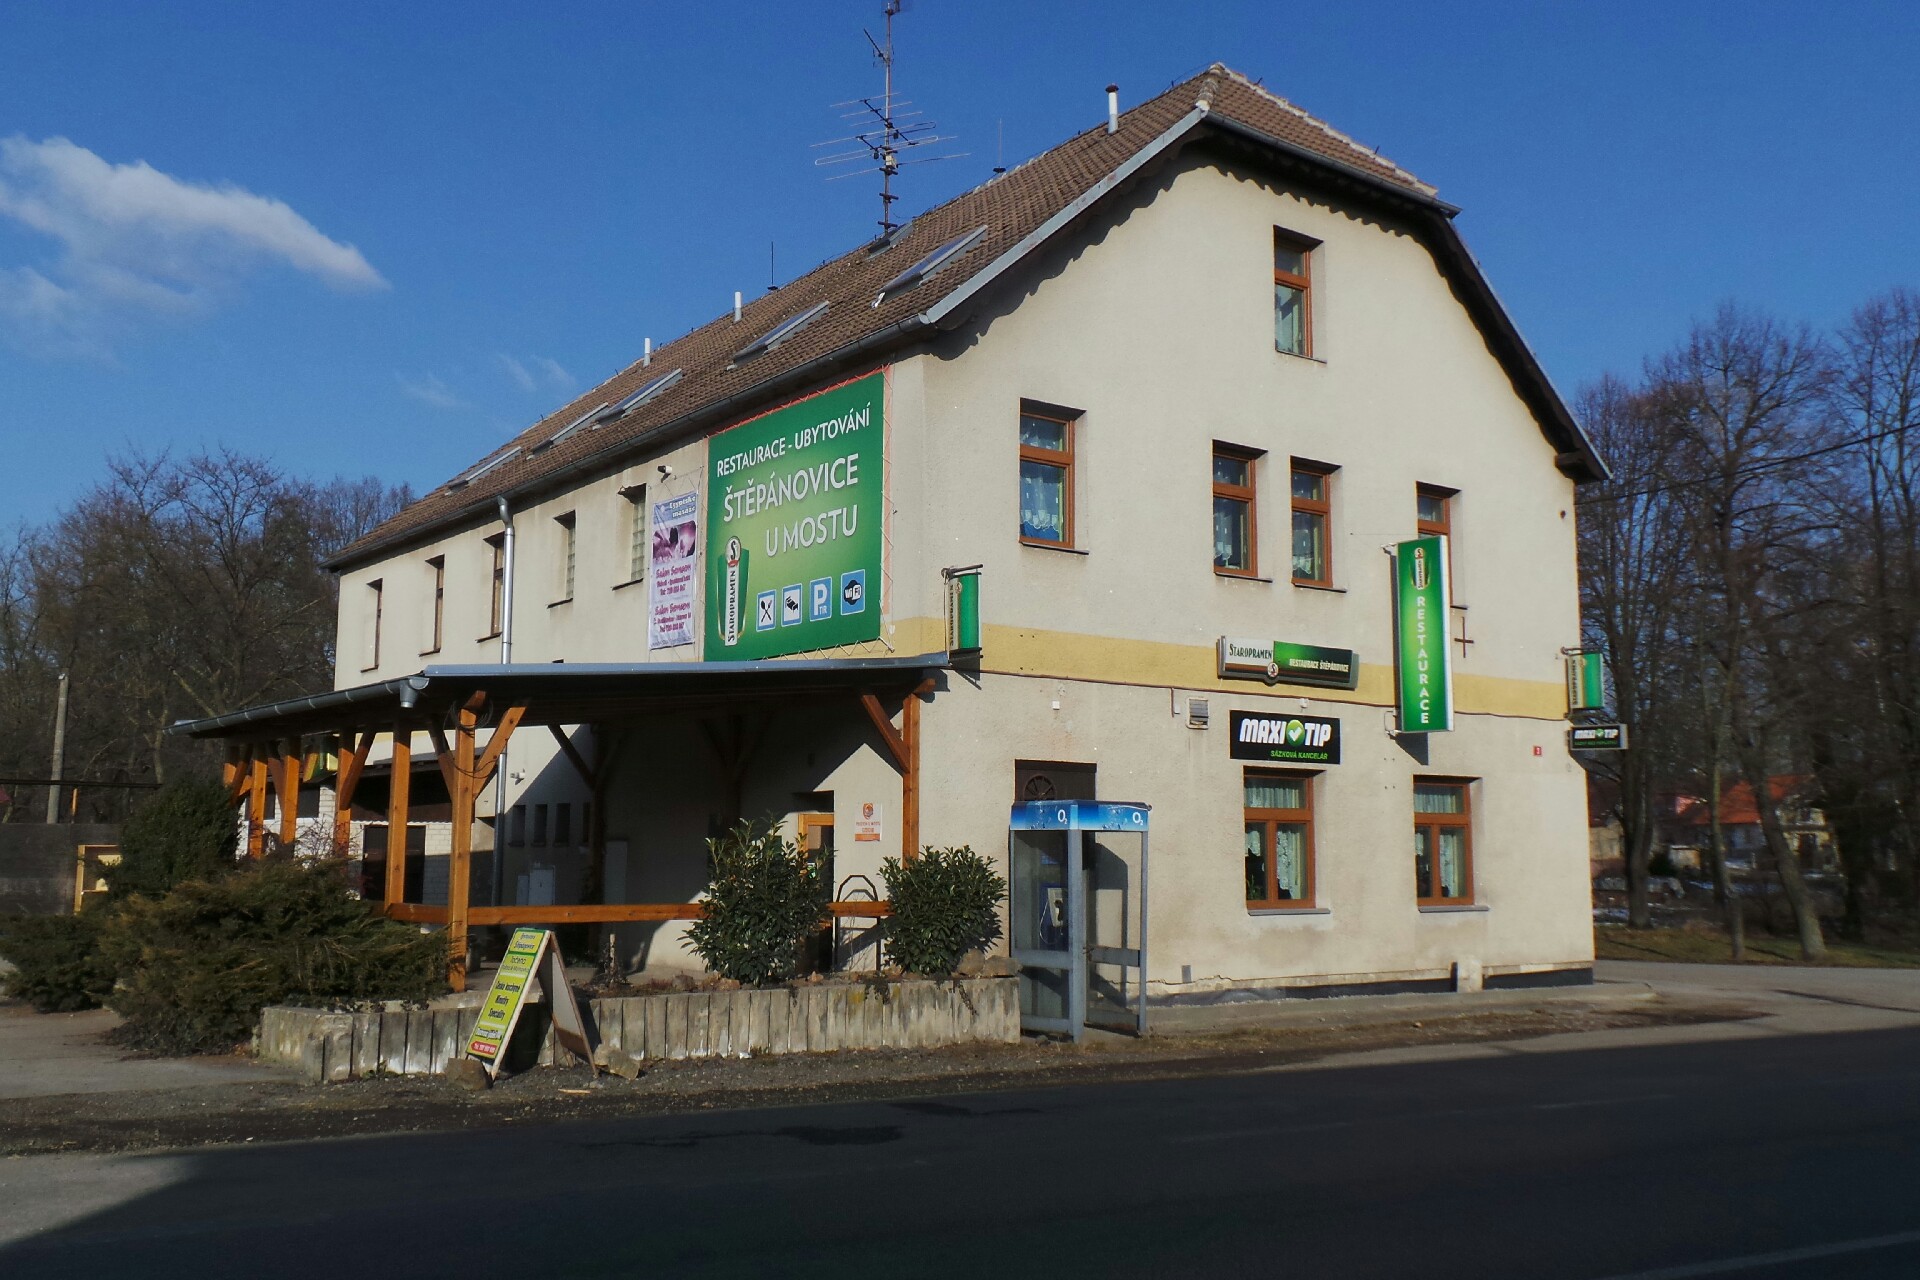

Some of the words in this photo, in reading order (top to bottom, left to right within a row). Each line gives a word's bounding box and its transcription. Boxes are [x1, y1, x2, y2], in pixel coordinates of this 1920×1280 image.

[717, 437, 786, 478] RESTAURACE
[794, 401, 871, 450] UBYTOVÁNÍ
[723, 453, 859, 522] ŠTĚPÁNOVICE
[766, 527, 778, 557] U
[783, 504, 858, 553] MOSTU
[727, 570, 736, 642] STAROPRAMEN
[814, 583, 828, 616] P
[819, 604, 828, 615] TIR
[1229, 643, 1272, 660] STAROPRAMEN
[1289, 658, 1319, 669] RESTAURACE
[1416, 596, 1430, 724] RESTAURACE
[1239, 718, 1287, 744] MAXI
[1304, 722, 1332, 747] TIP
[1270, 750, 1298, 758] SÁZKOVÁ
